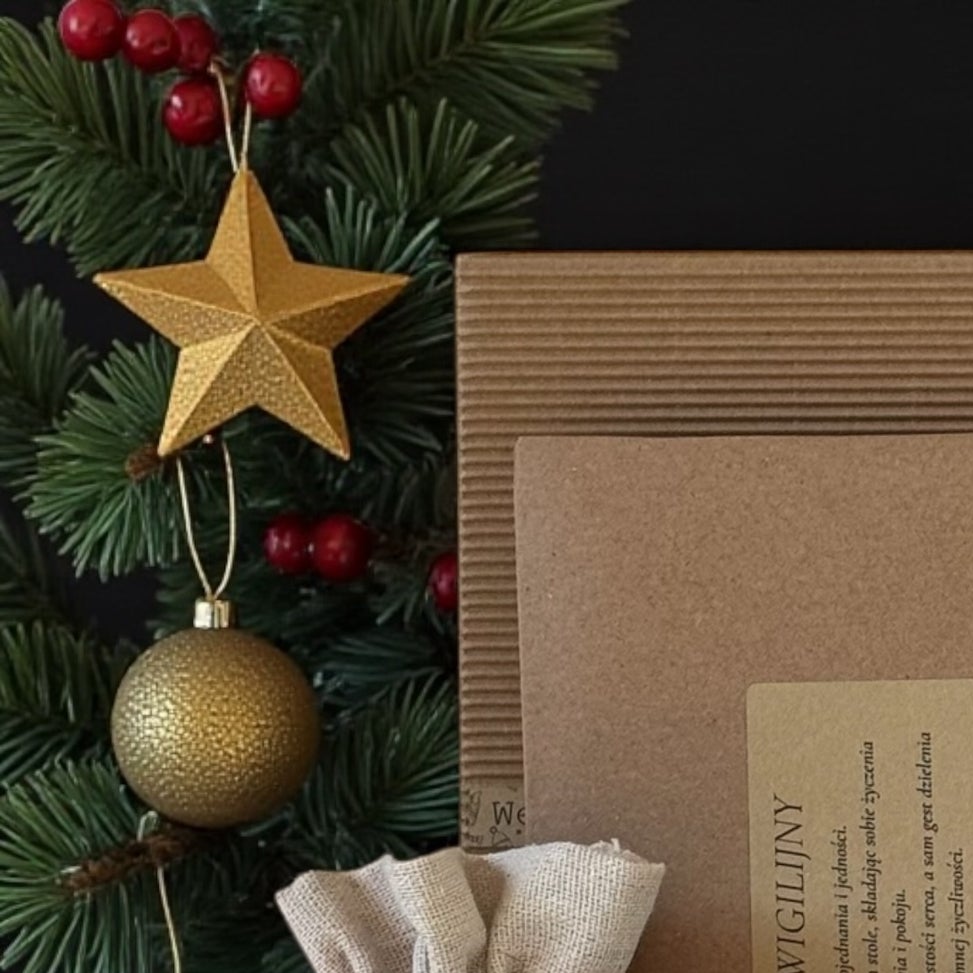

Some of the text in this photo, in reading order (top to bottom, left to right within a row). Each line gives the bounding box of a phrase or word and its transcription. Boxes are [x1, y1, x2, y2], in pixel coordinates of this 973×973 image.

[859, 741, 880, 803] życzenia
[917, 732, 933, 798] dzielenia
[859, 808, 876, 846] sobie
[920, 803, 938, 833] gest
[831, 825, 853, 891] jedności.
[922, 836, 934, 867] sam
[861, 851, 882, 921] składając
[924, 872, 935, 880] a
[947, 848, 970, 934] życzliwości.
[891, 889, 911, 943] pokoju.
[920, 886, 936, 928] serca,
[862, 927, 879, 965] stole,
